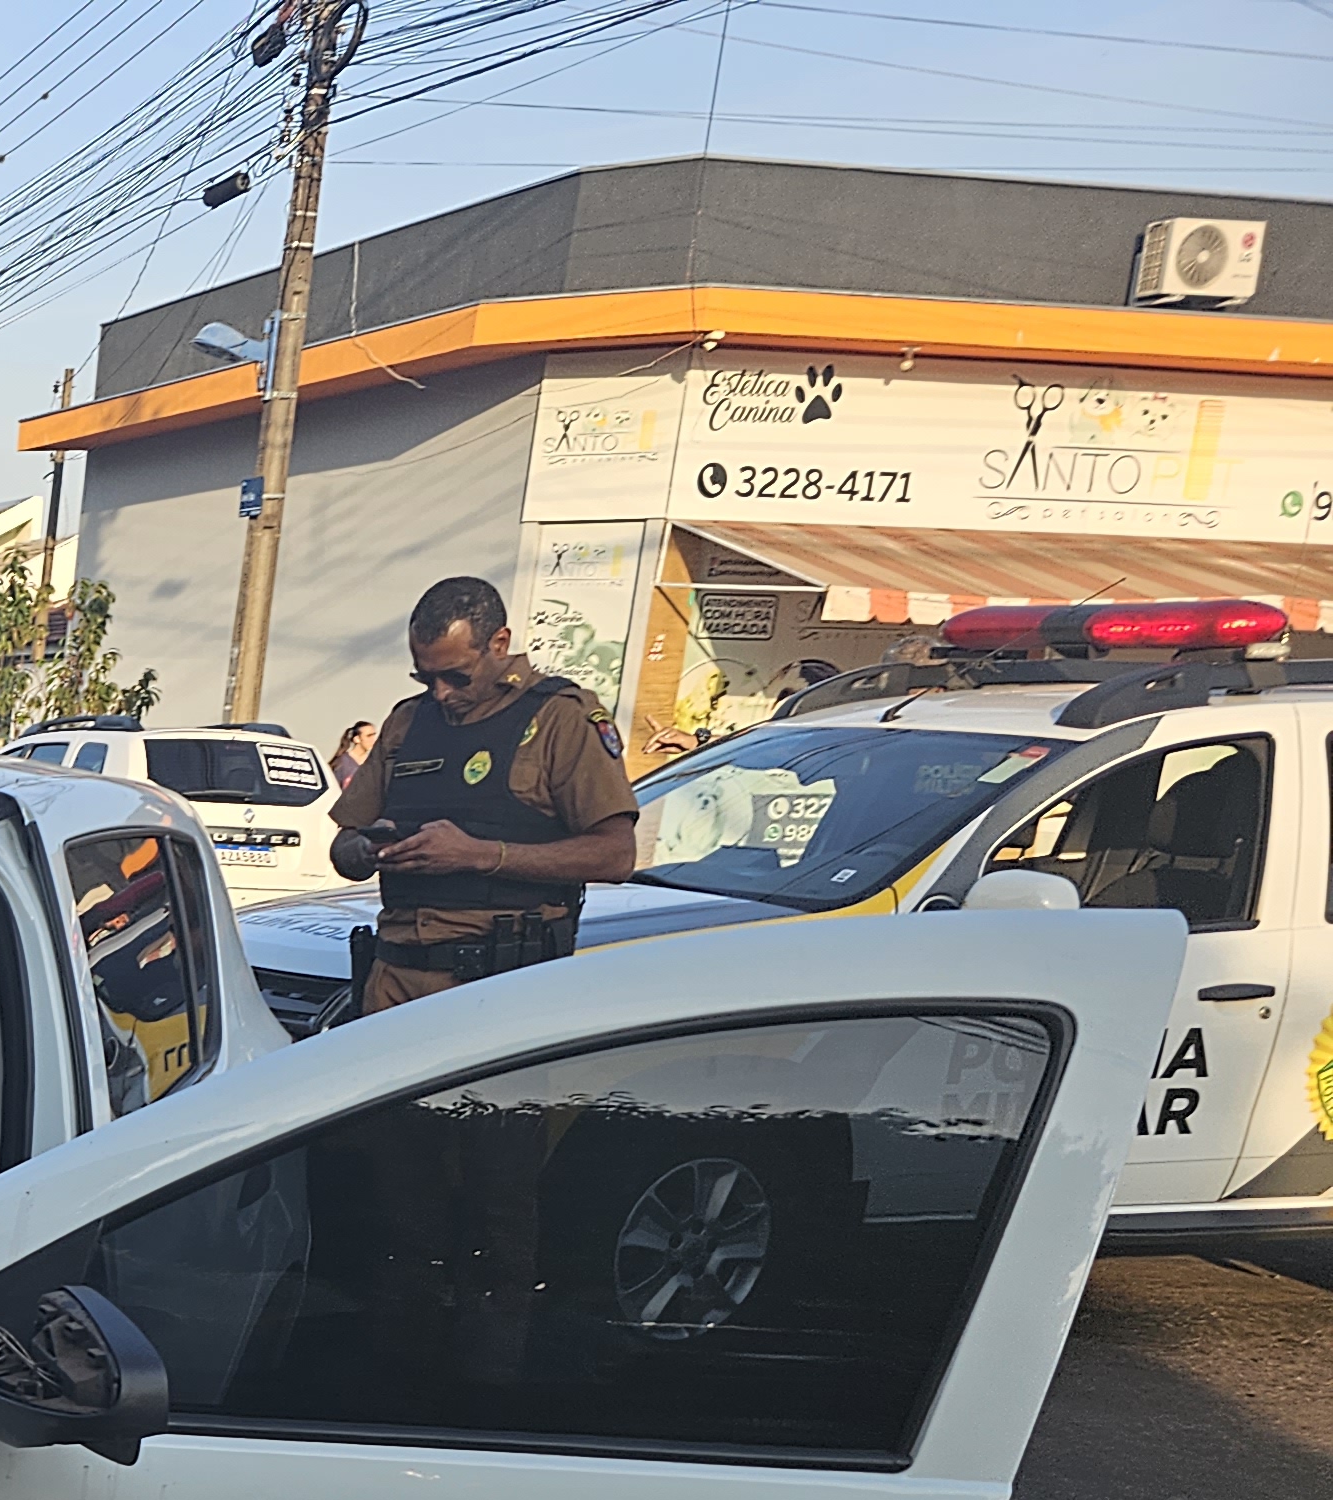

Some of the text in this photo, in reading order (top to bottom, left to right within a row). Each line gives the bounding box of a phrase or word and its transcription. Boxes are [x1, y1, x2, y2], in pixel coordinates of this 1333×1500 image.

[702, 368, 793, 406] Estética
[708, 397, 799, 432] Canina
[734, 465, 913, 503] 3228-4171
[978, 445, 1143, 495] SANTO
[703, 621, 768, 635] MARCADA
[704, 608, 733, 620] COM
[212, 832, 300, 845] USTER
